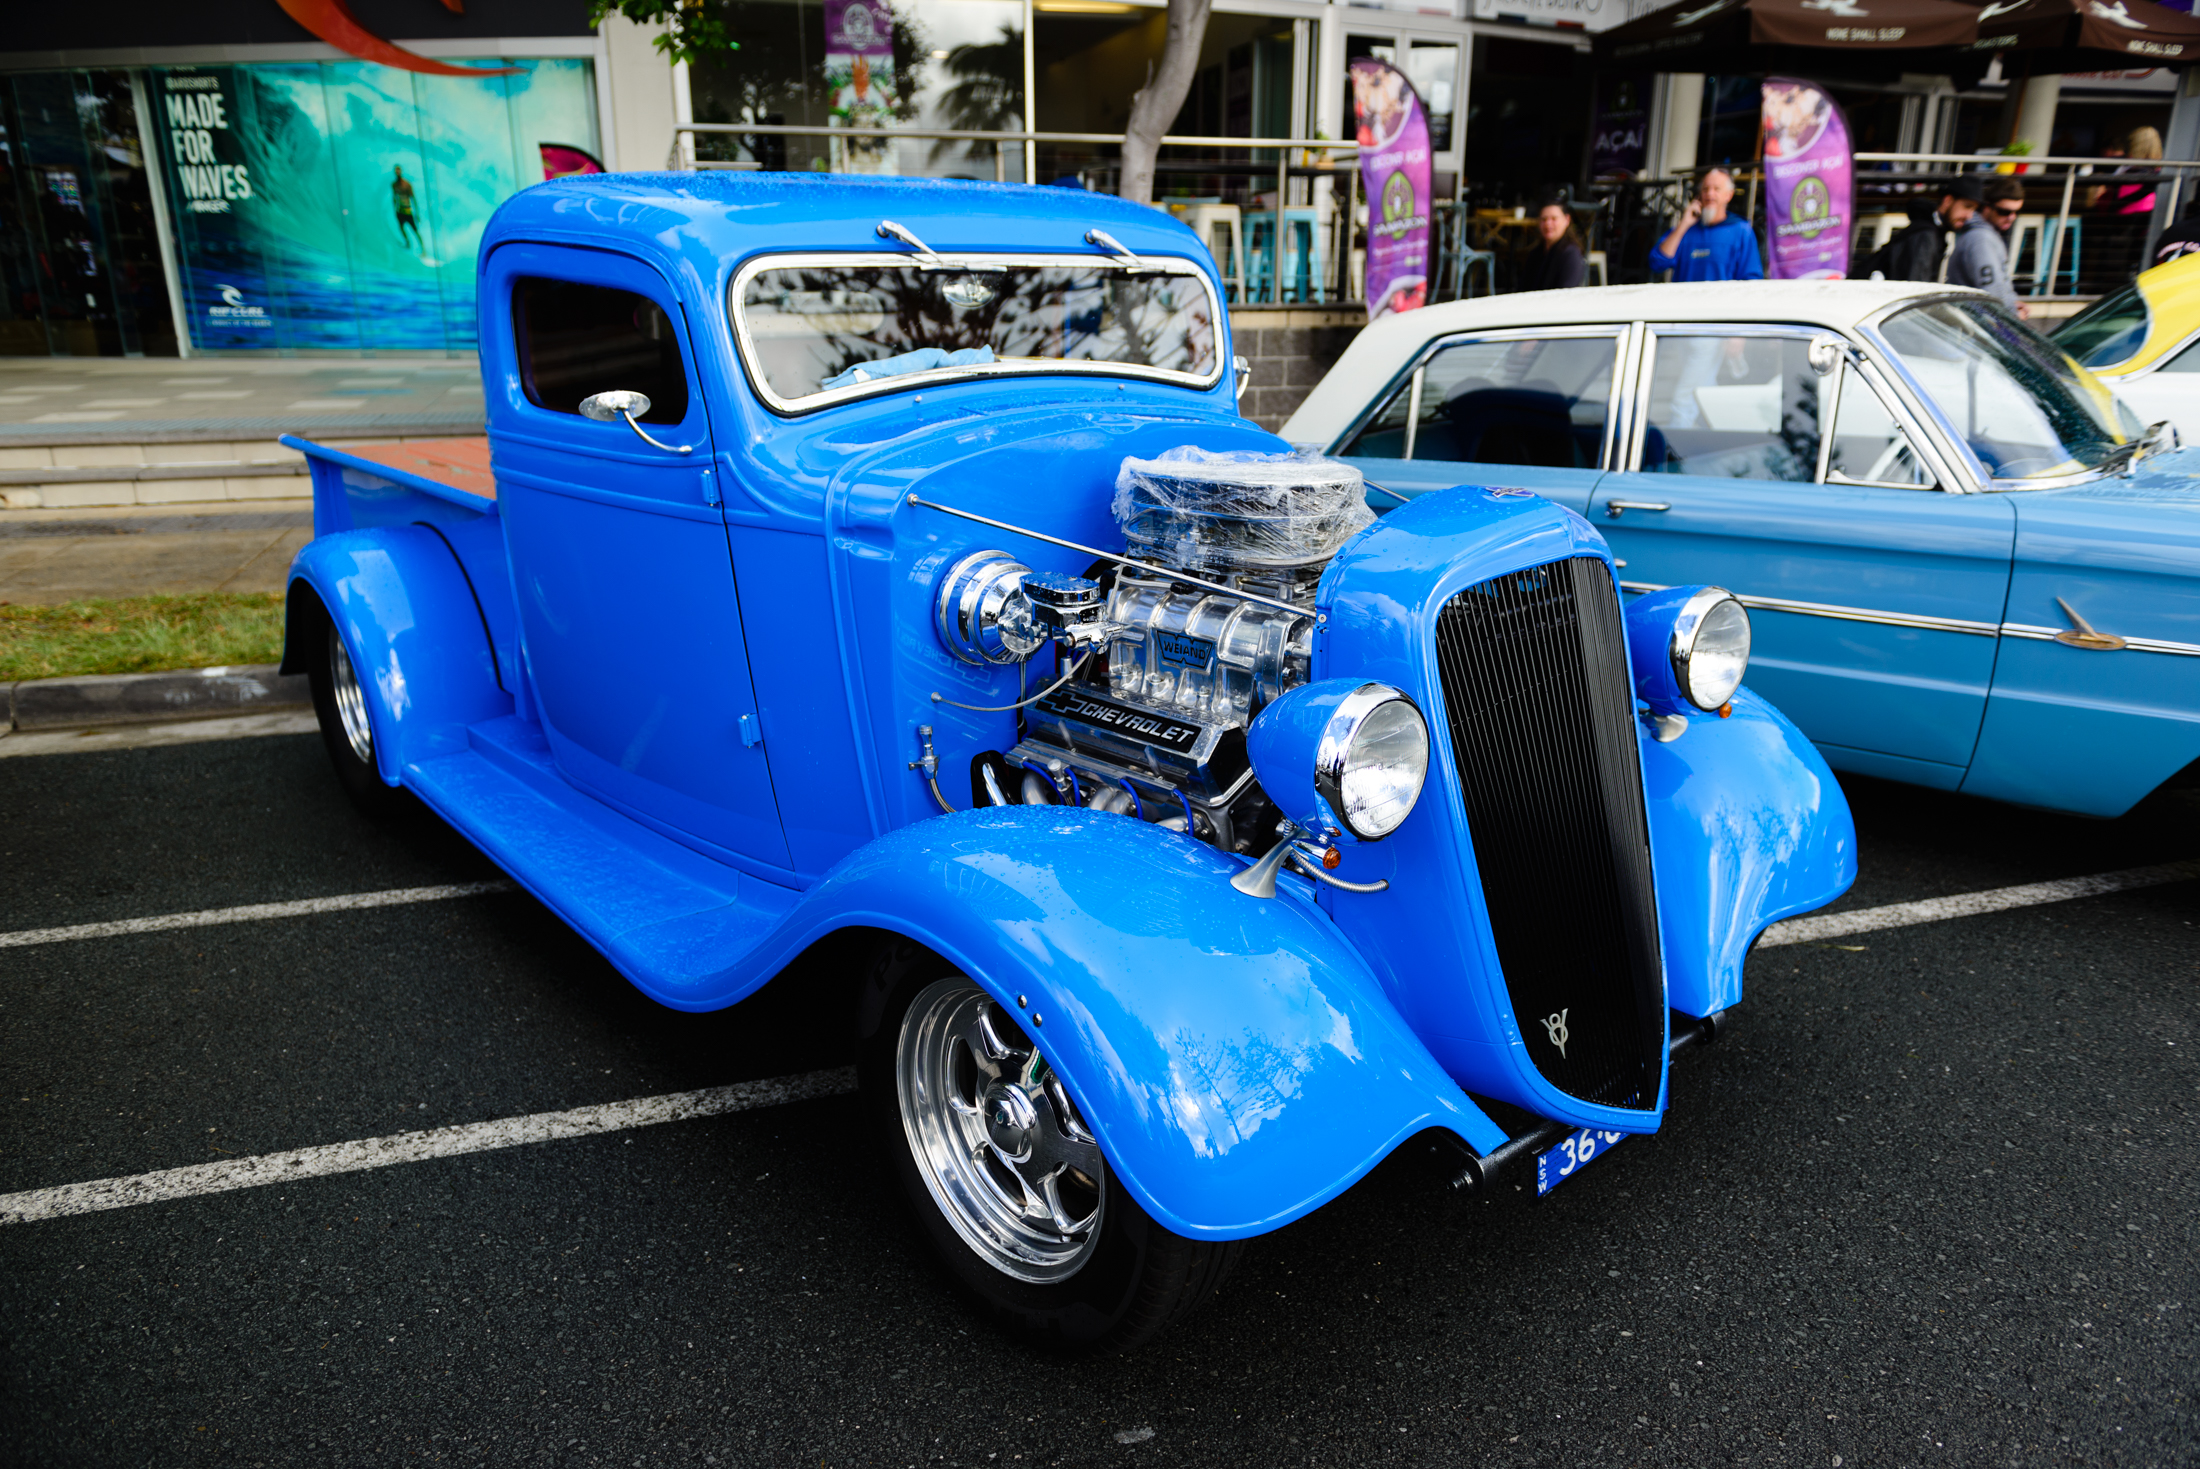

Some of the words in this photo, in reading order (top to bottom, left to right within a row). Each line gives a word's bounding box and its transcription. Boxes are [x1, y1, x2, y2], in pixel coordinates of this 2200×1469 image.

[164, 93, 229, 130] MADE
[171, 129, 217, 165] FOR
[1776, 216, 1841, 237] SAMBAZON
[1163, 640, 1206, 660] WEIAND
[1081, 702, 1195, 743] CHEVROLET
